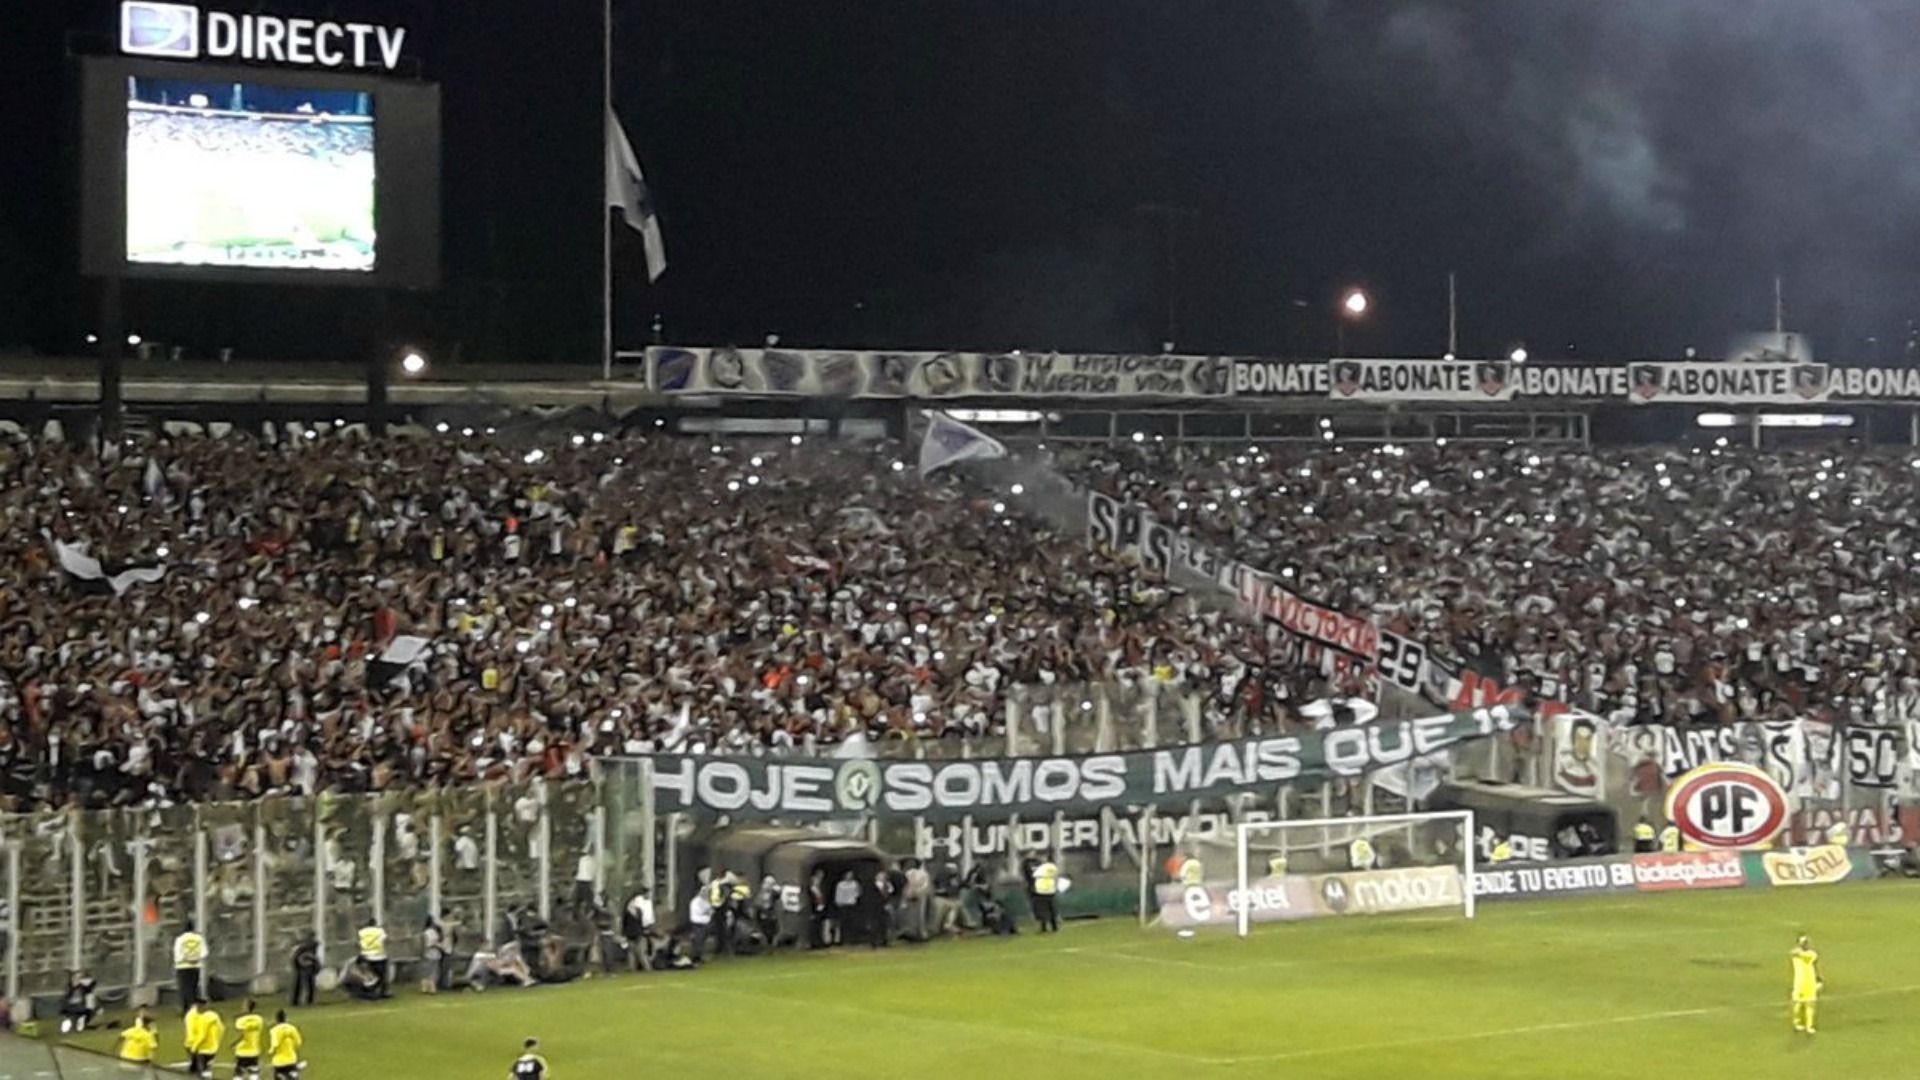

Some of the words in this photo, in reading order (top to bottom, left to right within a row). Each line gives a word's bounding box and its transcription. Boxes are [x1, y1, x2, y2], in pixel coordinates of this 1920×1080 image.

[207, 11, 406, 69] DIRECTV
[1362, 364, 1472, 393] ABONATE
[1511, 366, 1628, 396] ABONATE
[1667, 368, 1791, 396] ABONATE
[1379, 631, 1421, 688] 29
[650, 757, 834, 812] HOJE
[884, 755, 1127, 811] SOMOS
[1153, 736, 1300, 793] MAIS
[1324, 713, 1456, 775] QUE
[1701, 784, 1758, 834] PF
[972, 819, 1100, 854] UNDER
[1516, 868, 1542, 892] TU
[1542, 865, 1608, 891] EVENTO
